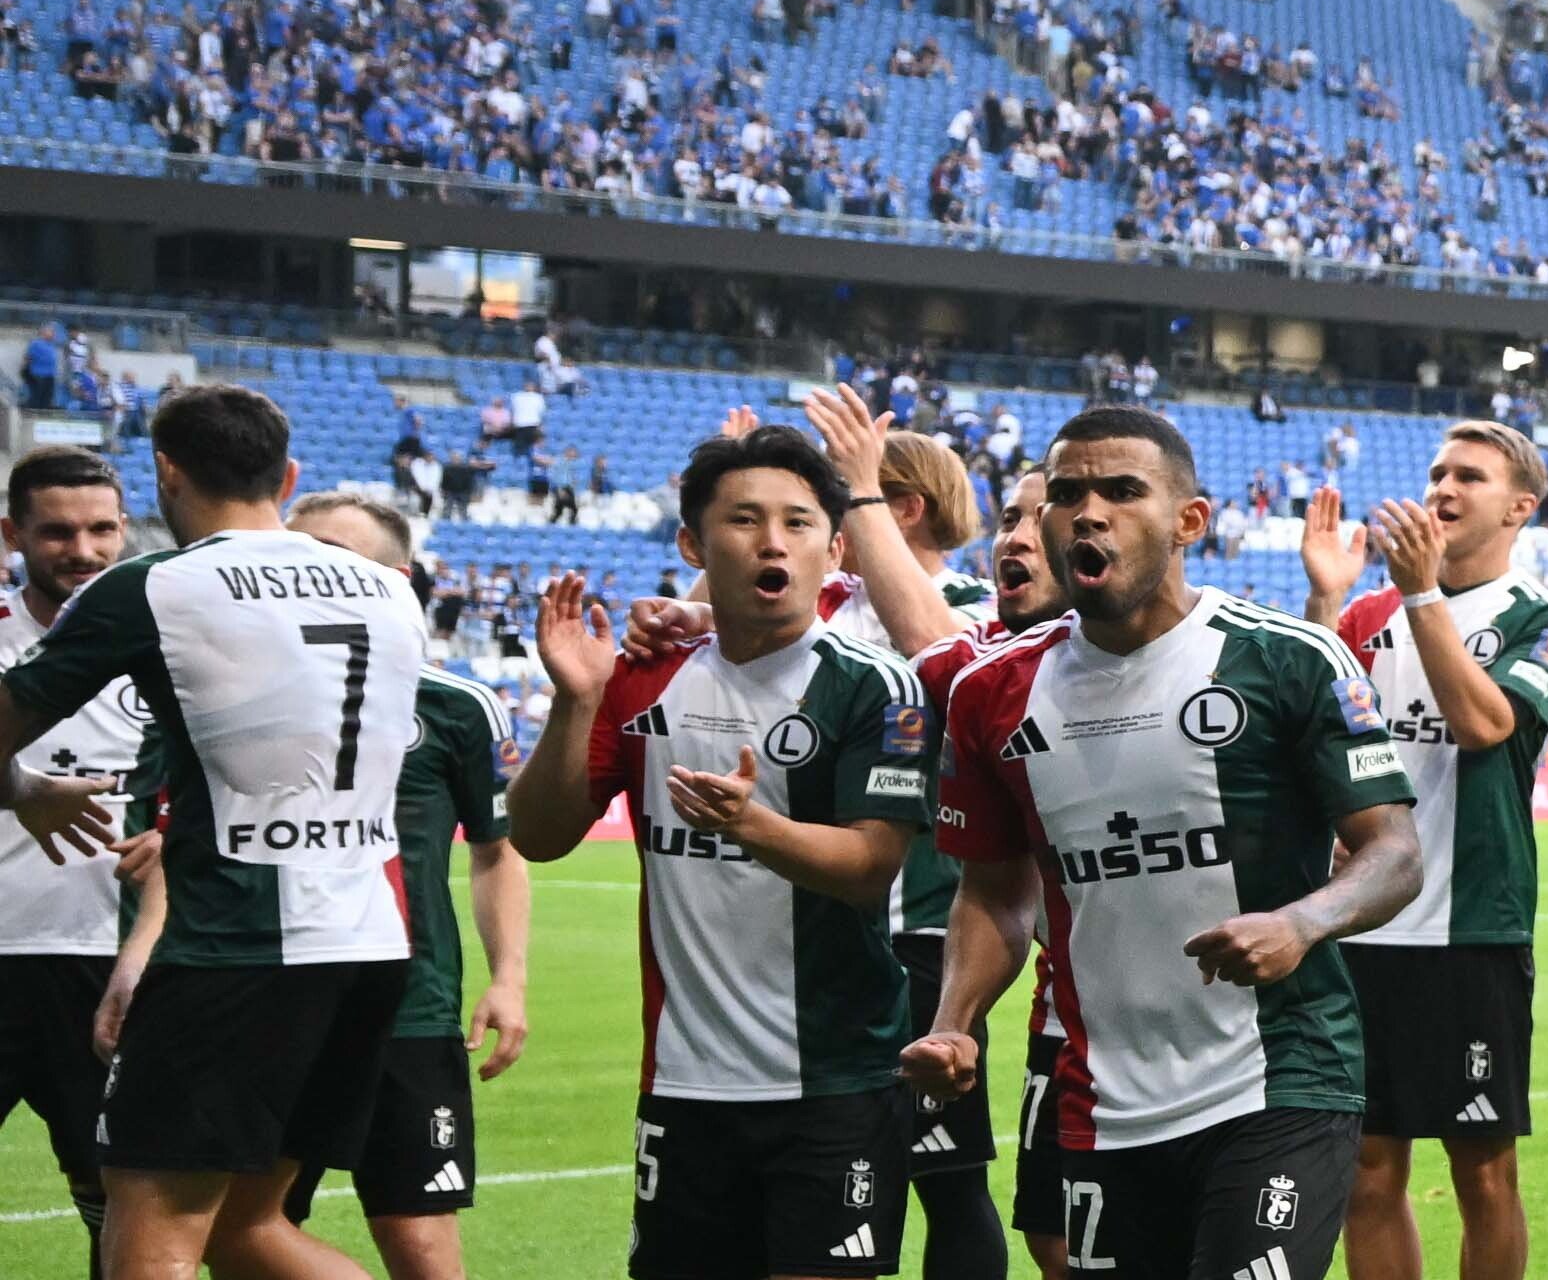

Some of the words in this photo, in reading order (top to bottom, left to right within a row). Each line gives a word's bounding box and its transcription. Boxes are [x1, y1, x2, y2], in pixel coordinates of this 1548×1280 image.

[299, 623, 369, 791] 7
[1356, 748, 1398, 773] Królew
[873, 772, 925, 790] Królews
